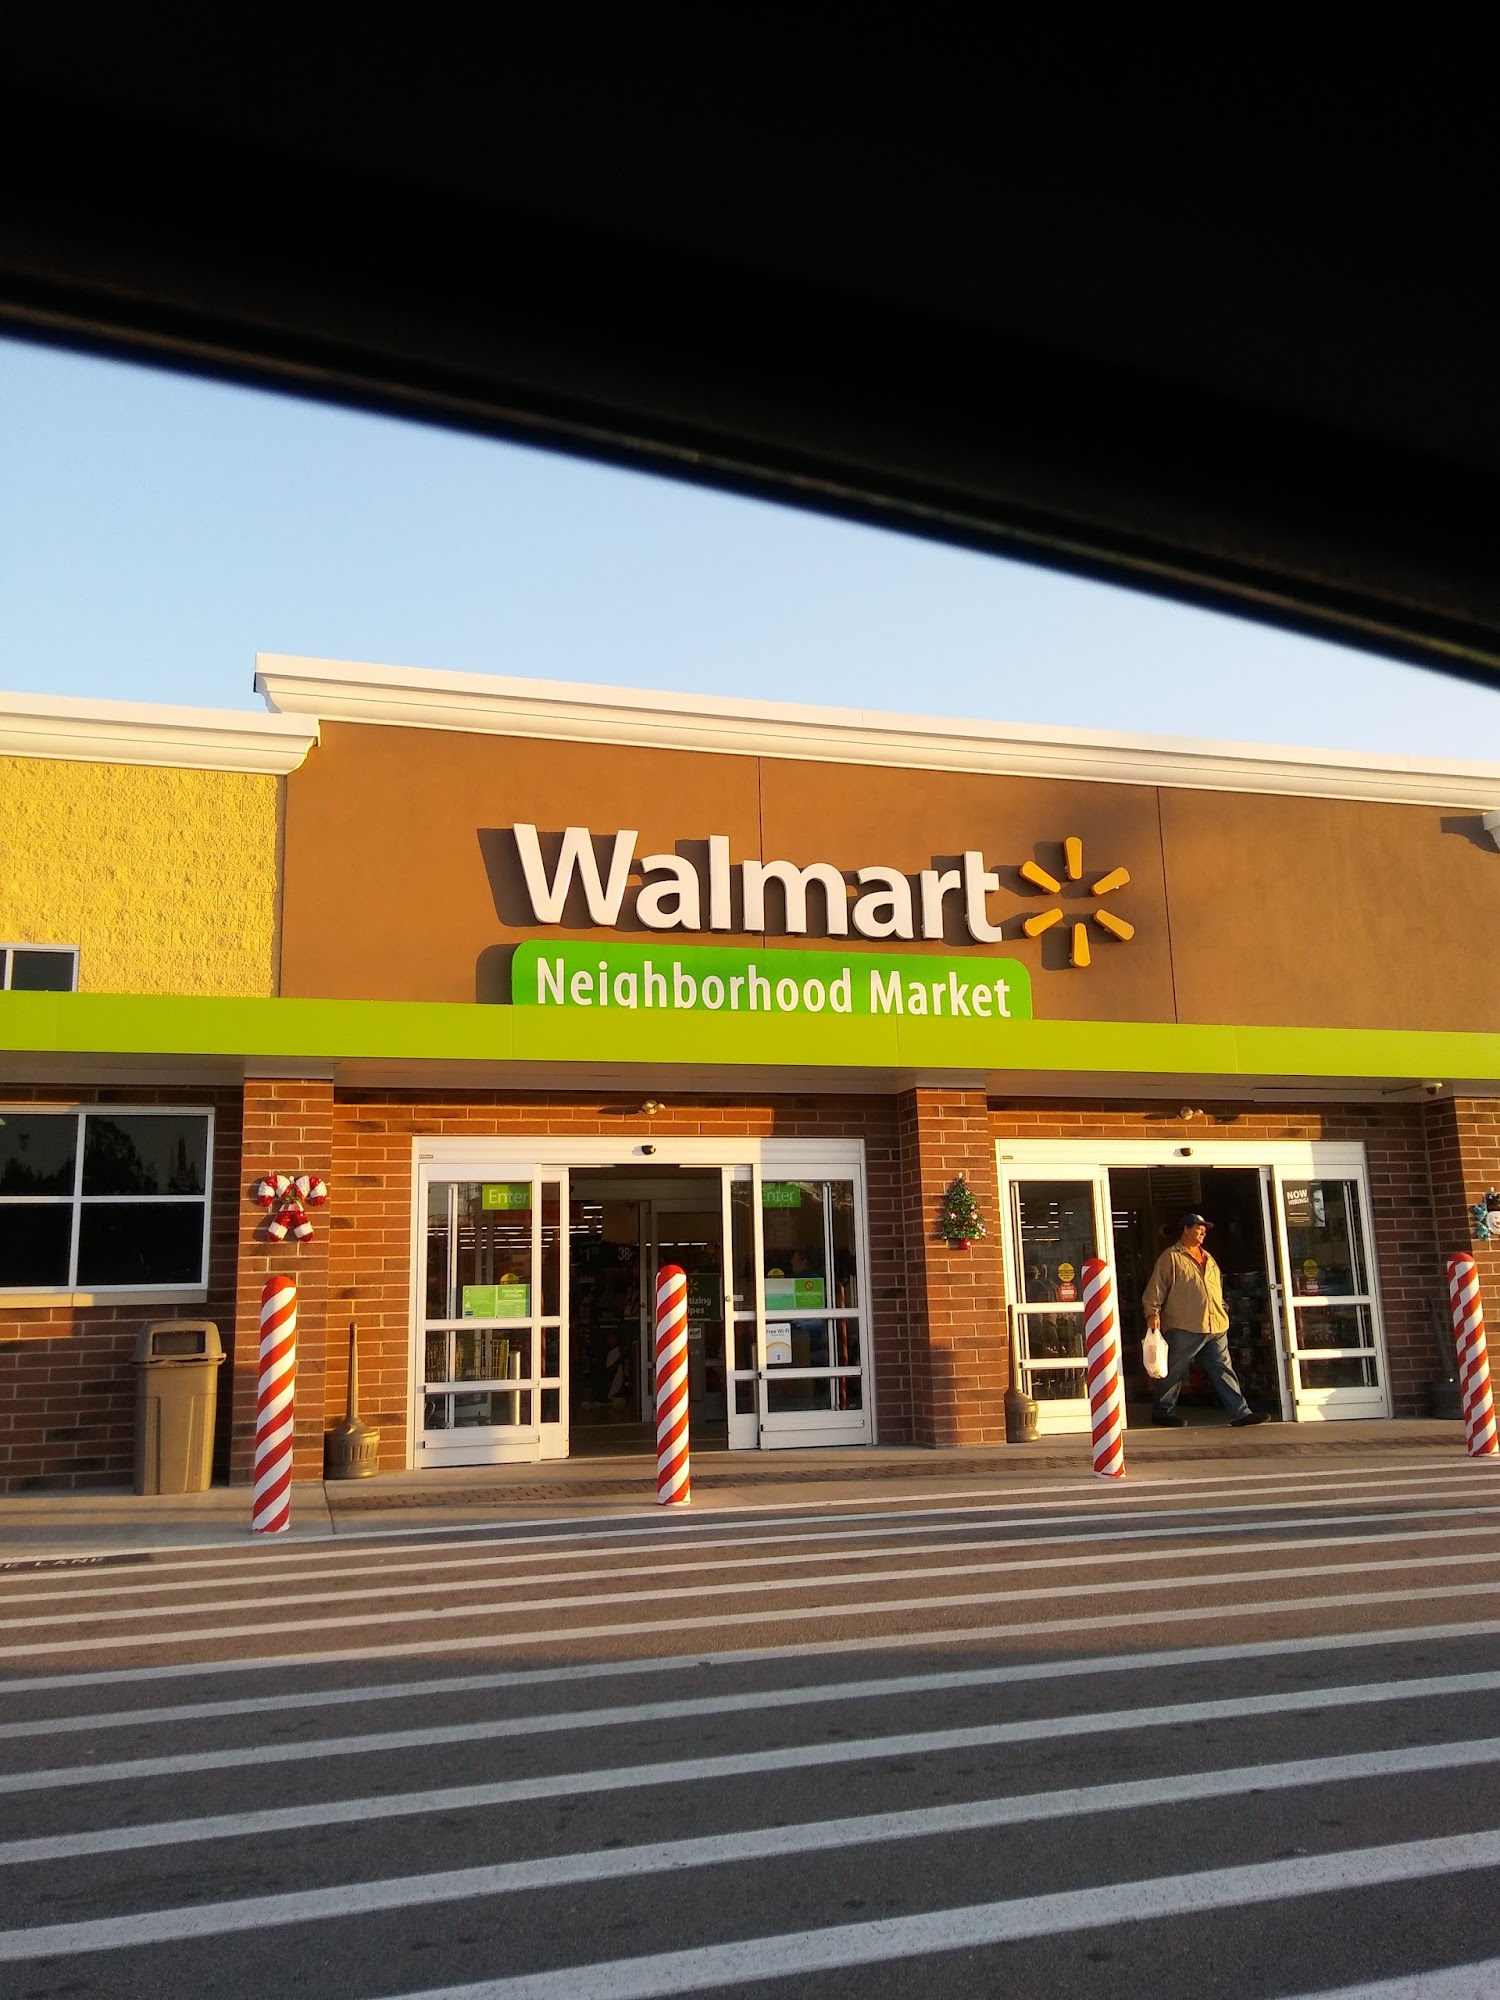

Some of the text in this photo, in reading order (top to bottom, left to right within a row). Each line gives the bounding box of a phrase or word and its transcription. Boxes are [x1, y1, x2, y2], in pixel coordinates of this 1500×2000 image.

[513, 822, 1003, 944] Walmart
[536, 957, 1012, 1018] Neighborhood Market
[489, 1189, 529, 1204] Enter
[1286, 1189, 1308, 1200] NOW
[1288, 1197, 1309, 1205] HIRING!
[688, 1297, 712, 1306] tizing
[687, 1306, 705, 1316] ipes
